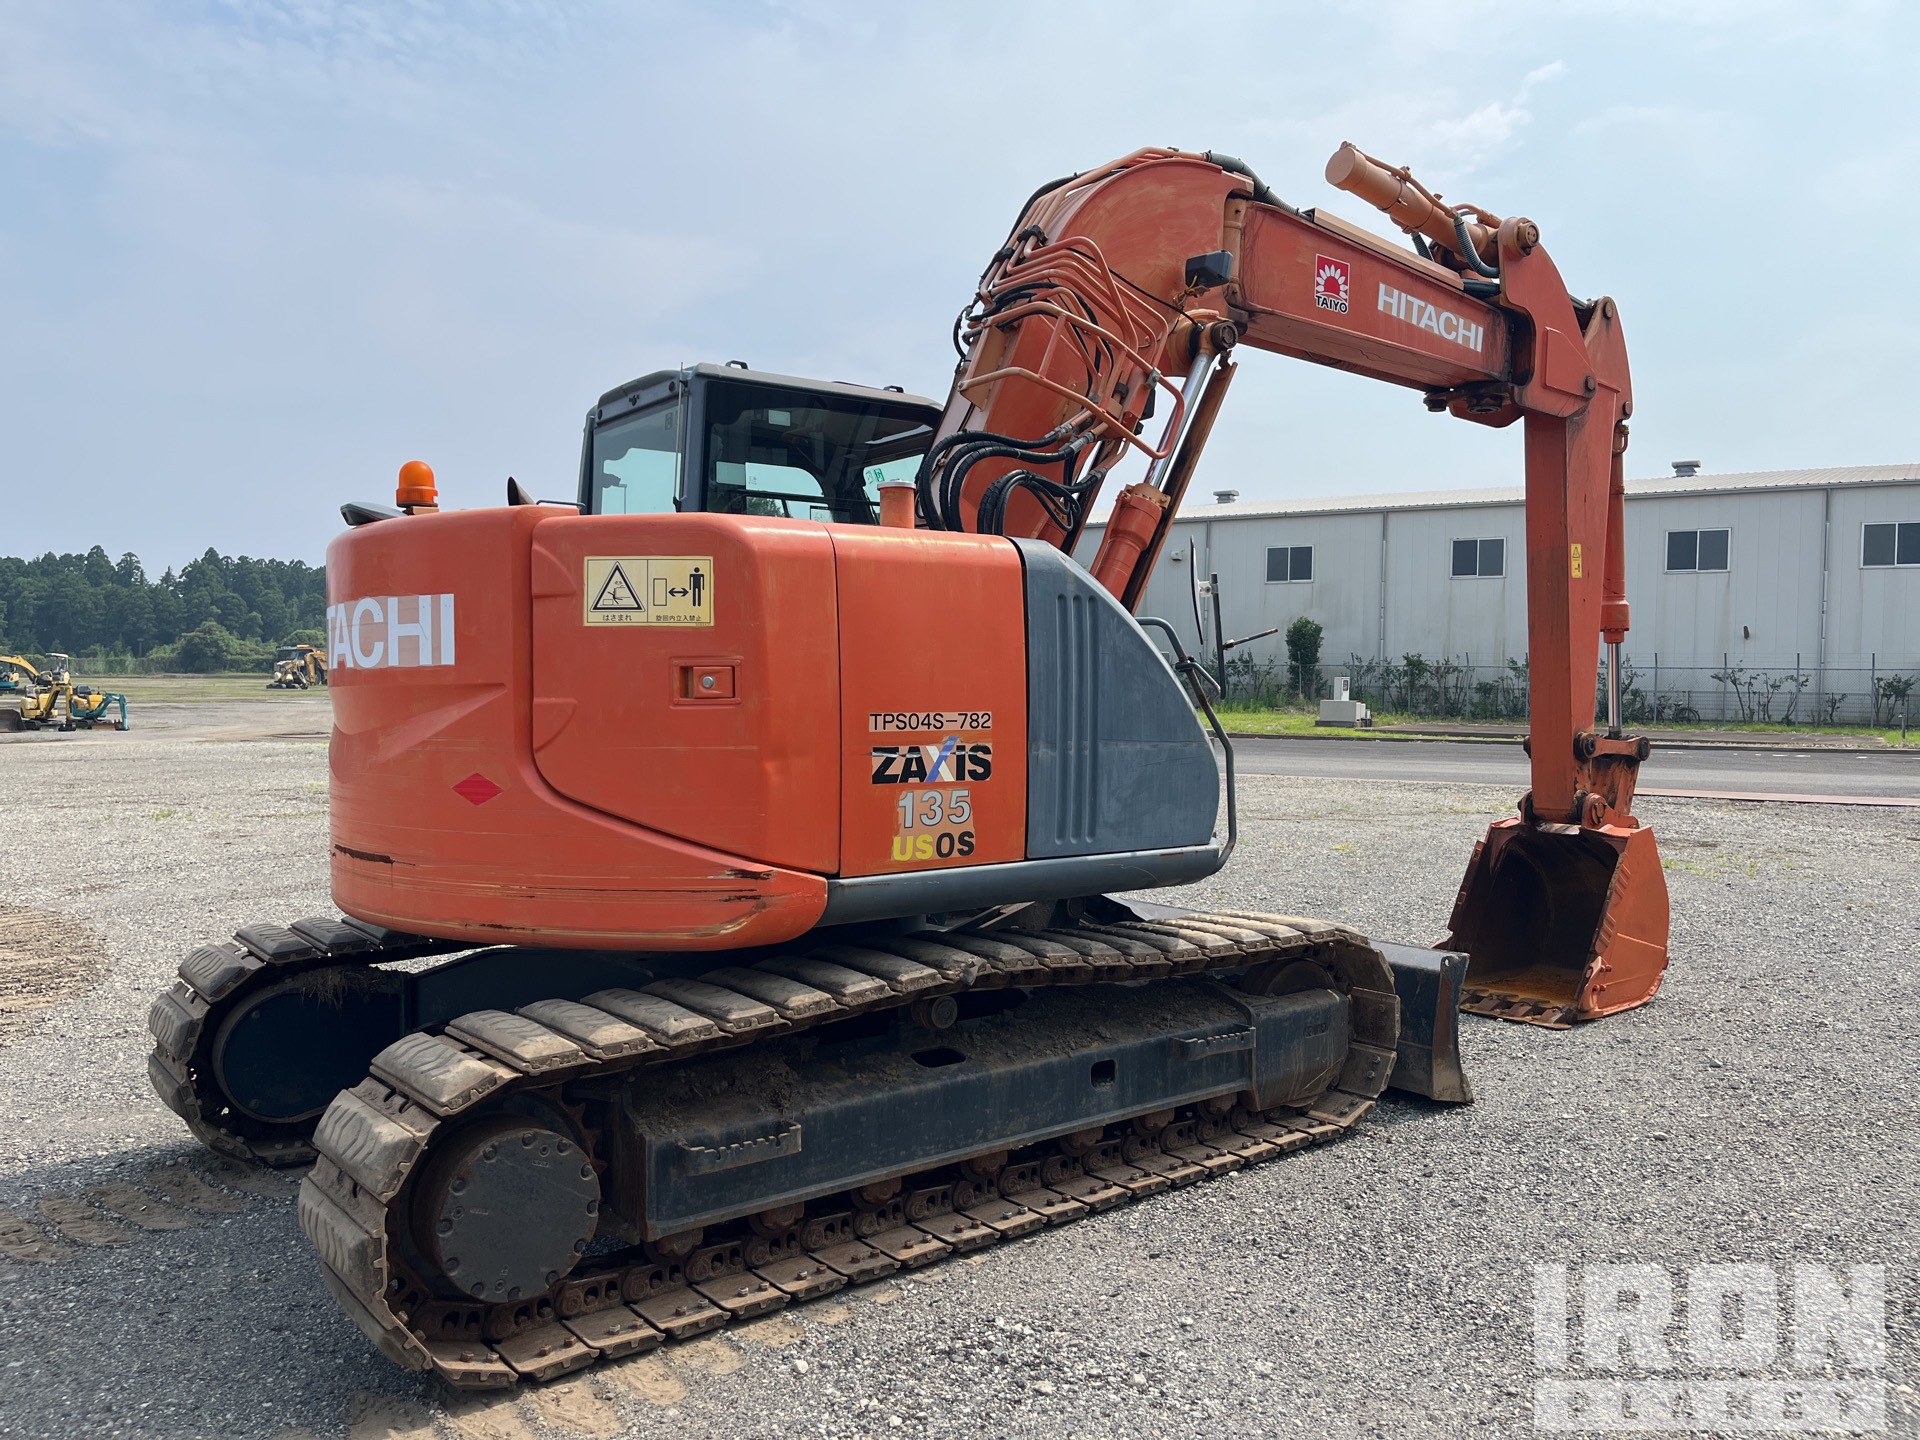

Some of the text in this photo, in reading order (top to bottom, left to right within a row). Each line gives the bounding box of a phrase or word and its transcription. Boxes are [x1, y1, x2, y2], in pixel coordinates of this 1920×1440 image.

[1315, 295, 1348, 313] TAIYO
[1377, 282, 1484, 353] HITACHI
[602, 614, 633, 622] はさまれ
[869, 712, 992, 731] TPS04S-782
[871, 735, 992, 784] ZAXIS
[898, 789, 972, 829] 135
[893, 830, 975, 862] USOS
